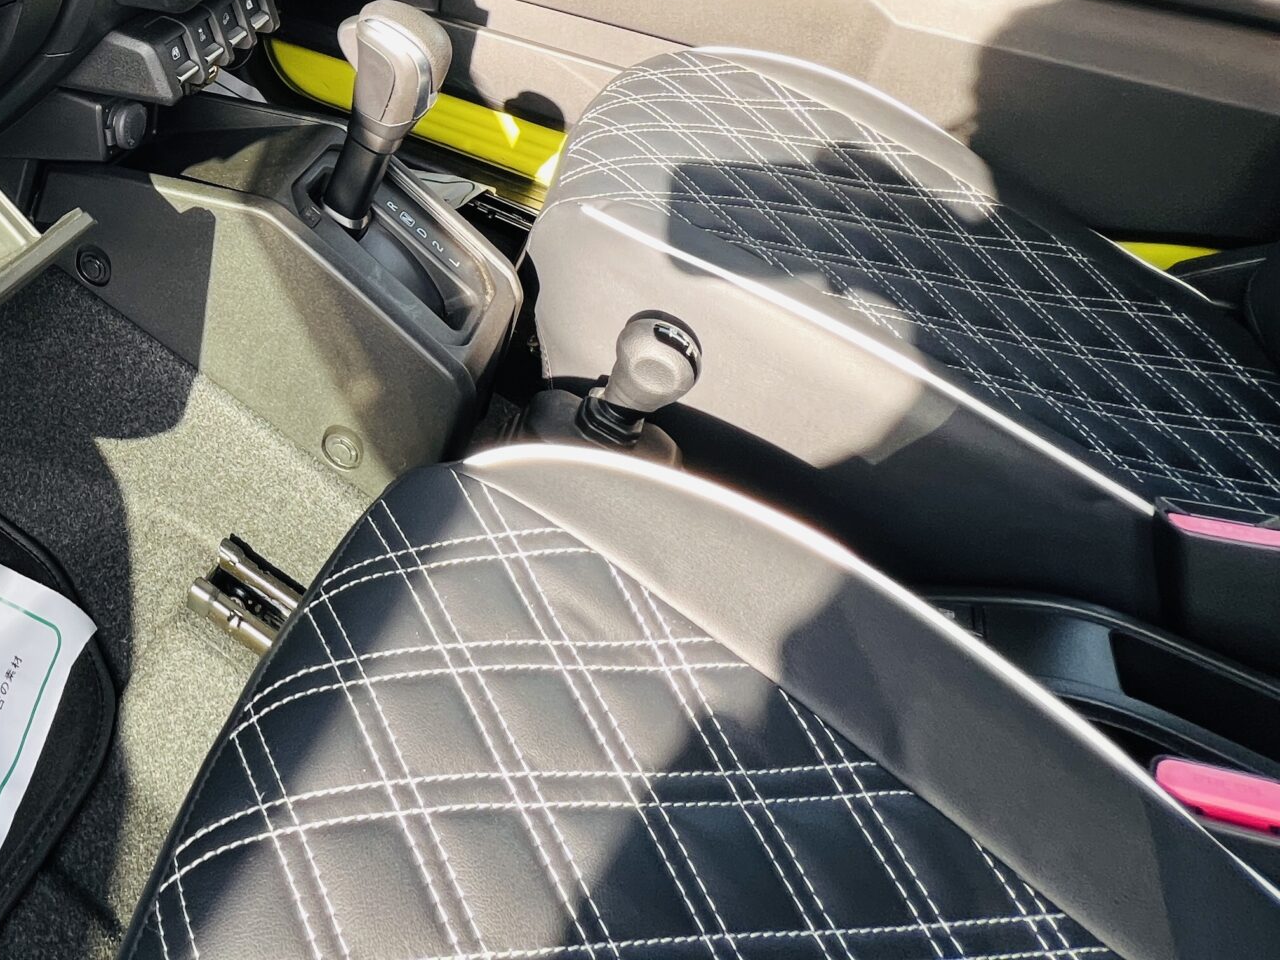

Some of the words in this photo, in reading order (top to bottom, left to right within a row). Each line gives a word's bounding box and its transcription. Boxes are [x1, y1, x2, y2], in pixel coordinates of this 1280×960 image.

[387, 201, 398, 212] R
[416, 227, 427, 238] D
[432, 240, 444, 253] 2
[448, 258, 460, 268] L
